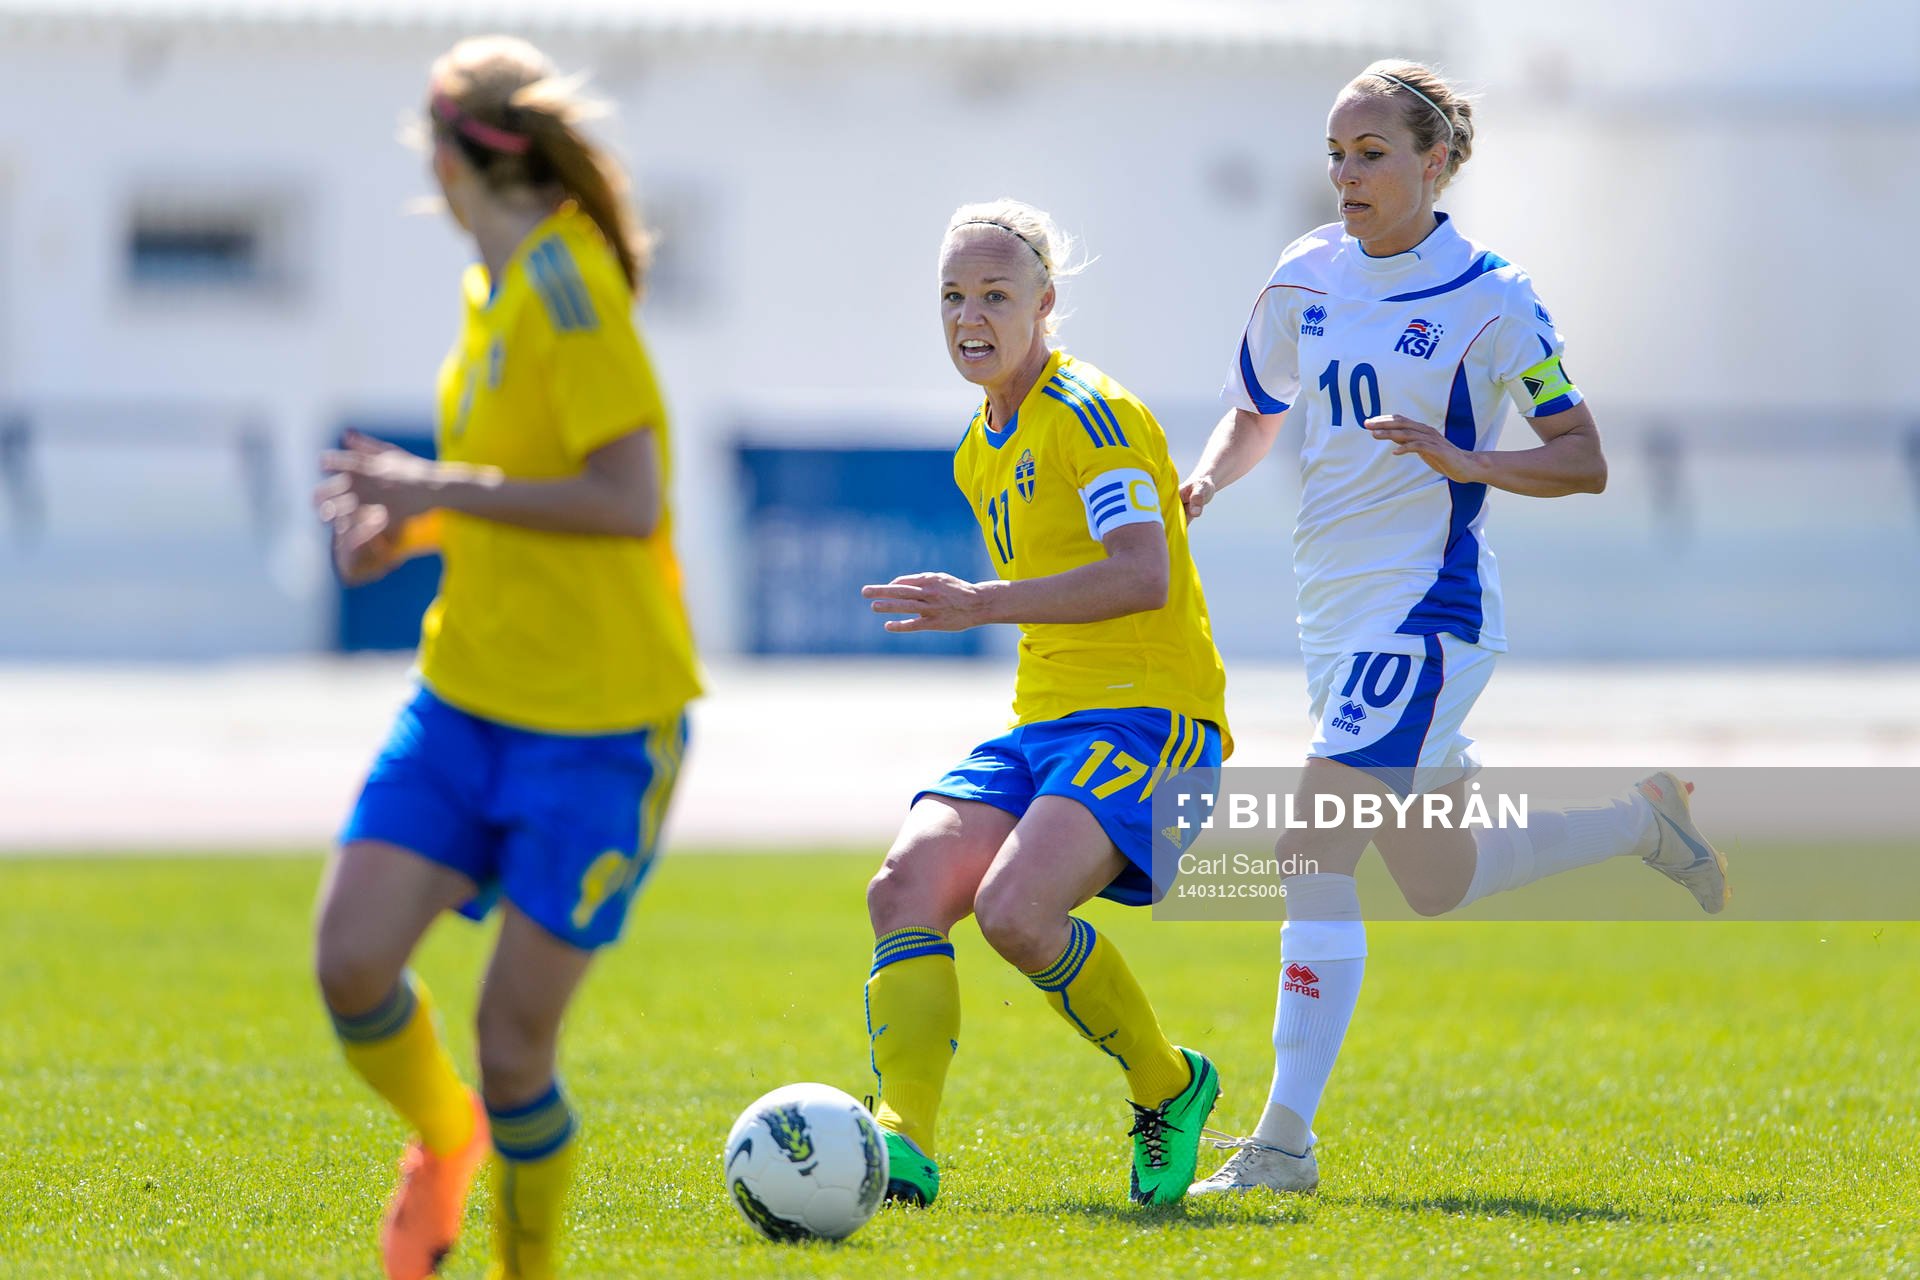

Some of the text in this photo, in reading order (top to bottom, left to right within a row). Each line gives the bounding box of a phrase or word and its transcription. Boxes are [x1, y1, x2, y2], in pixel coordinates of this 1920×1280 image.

[1319, 359, 1382, 430] 10
[1340, 651, 1412, 708] 10
[1071, 740, 1150, 801] 17
